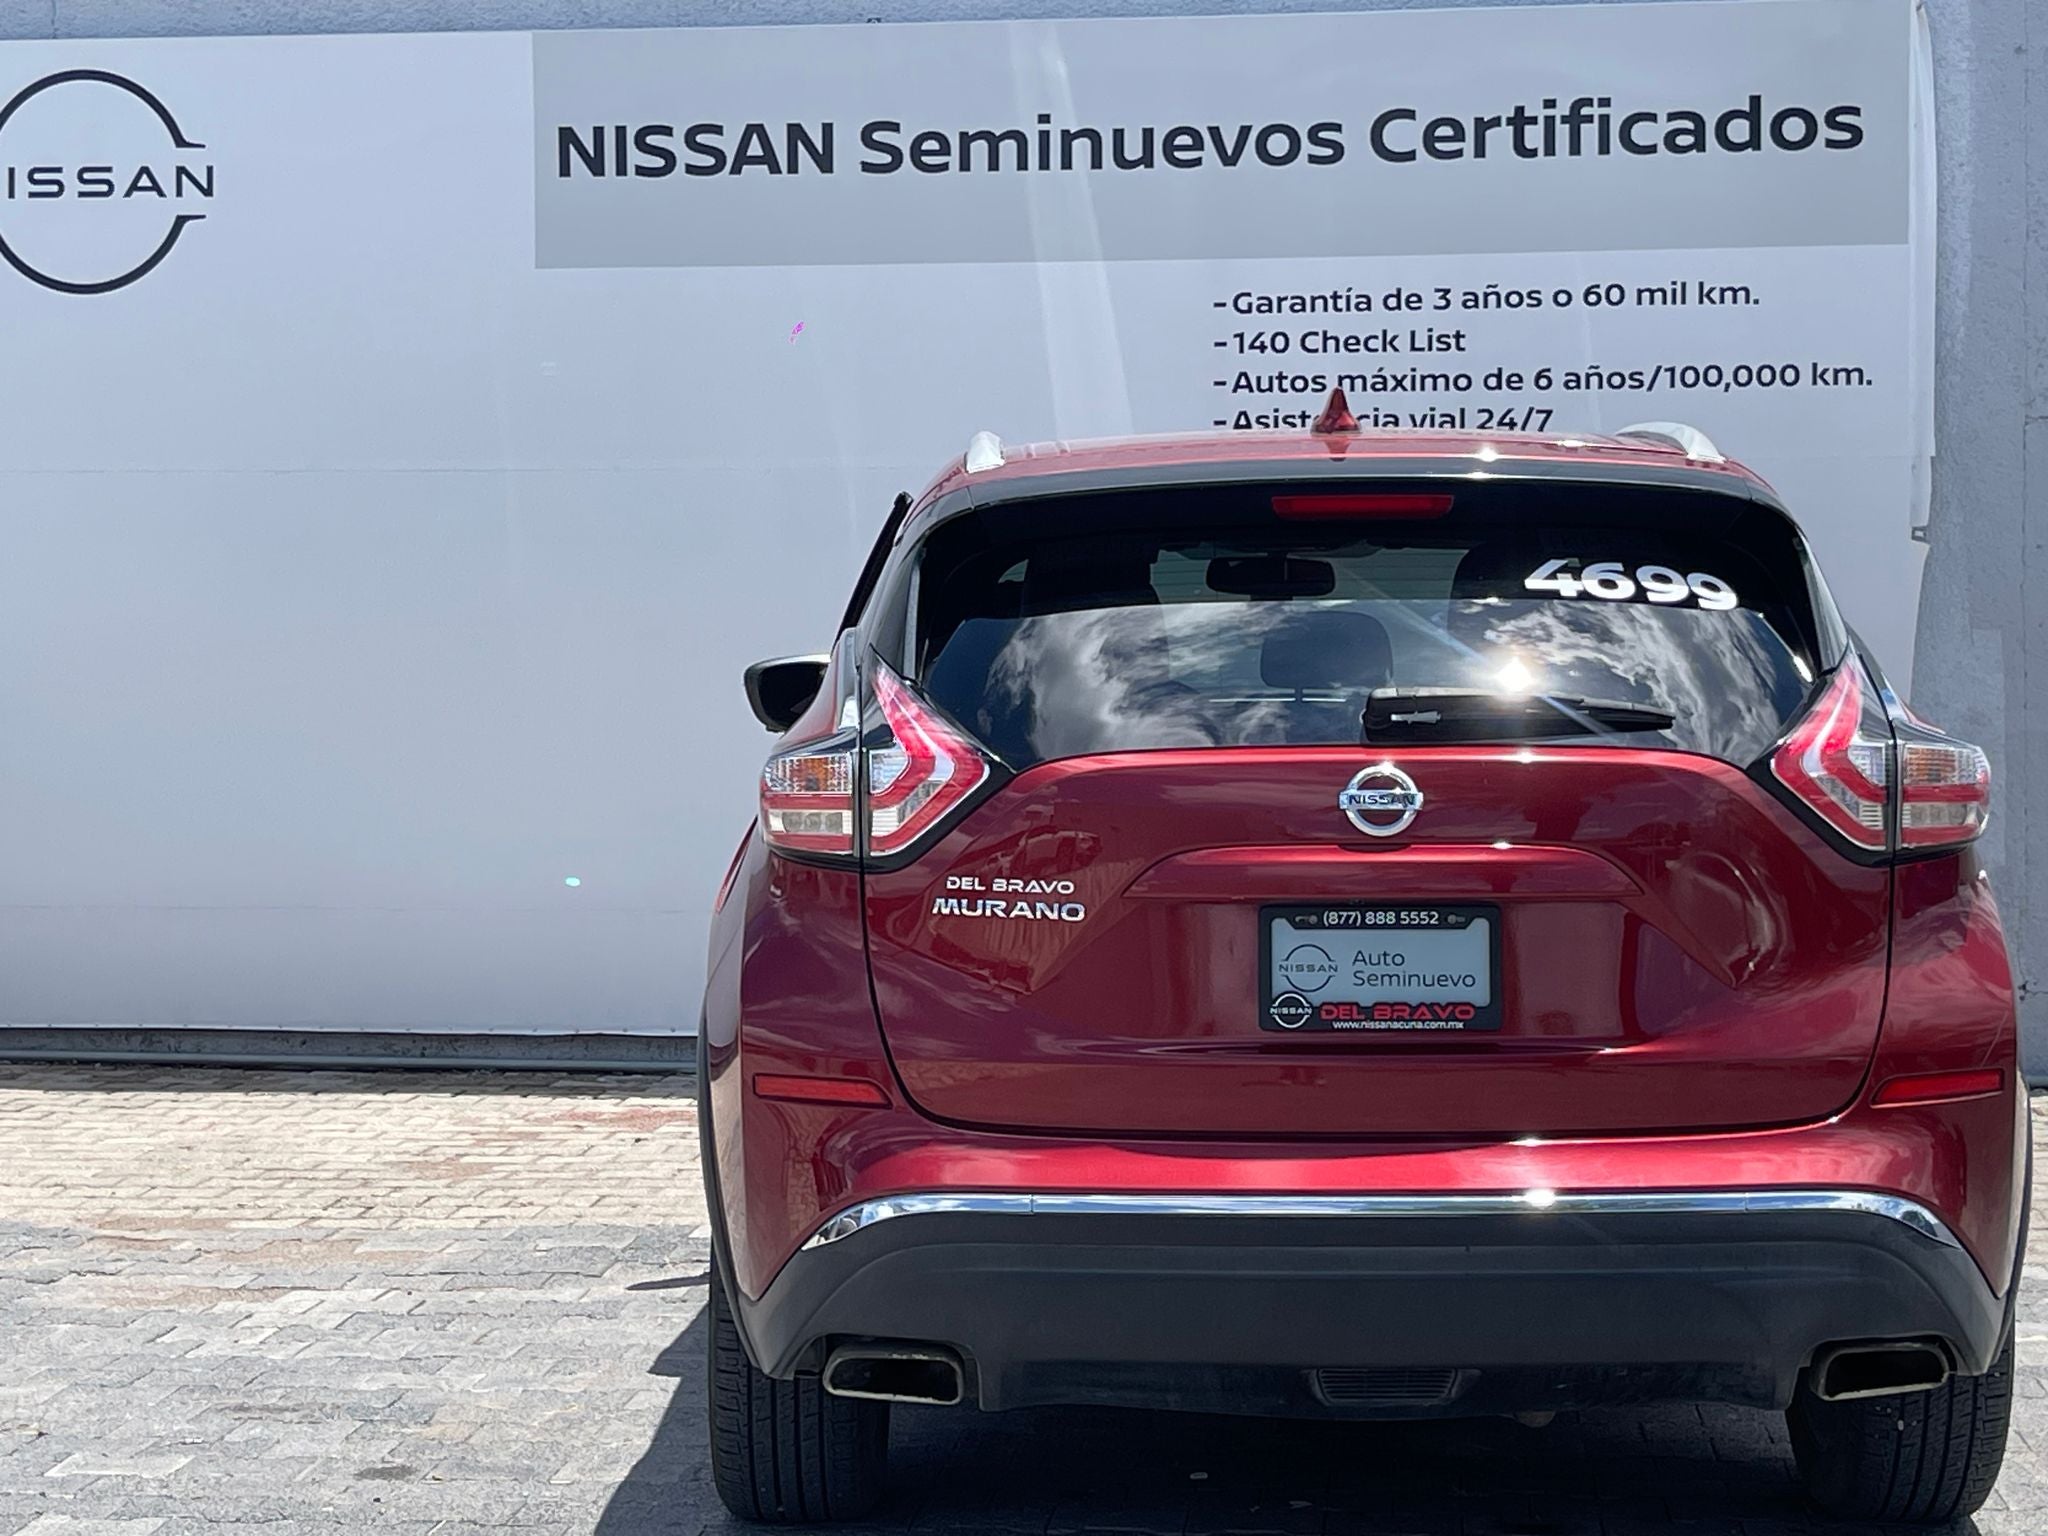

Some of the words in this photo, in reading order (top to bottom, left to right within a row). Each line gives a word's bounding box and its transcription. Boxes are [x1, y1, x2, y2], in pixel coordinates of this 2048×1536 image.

[558, 122, 834, 178] NISSAN
[859, 113, 1345, 174] Seminuevos
[1370, 94, 1864, 163] Certificados
[8, 165, 214, 198] ISSAN
[1382, 287, 1423, 312] de
[1433, 287, 1452, 311] 3
[1461, 283, 1543, 310] años
[1552, 289, 1573, 308] o
[1583, 283, 1626, 307] 60
[1636, 280, 1687, 306] mil
[1698, 281, 1760, 305] km.
[1300, 328, 1400, 354] Check
[1409, 327, 1466, 352] List
[1336, 366, 1473, 393] máximo
[1483, 366, 1524, 391] de
[1533, 367, 1553, 391] 6
[1562, 363, 1801, 393] años/100,000
[1811, 362, 1873, 386] km.
[1408, 406, 1466, 430] vial
[1476, 406, 1554, 433] 24/7
[1524, 558, 1739, 611] 4699
[1348, 793, 1416, 807] NISSAN
[946, 876, 986, 891] DEL
[992, 878, 1075, 895] BRAVO
[932, 897, 1085, 922] MURANO
[1323, 910, 1362, 927] (877)
[1365, 911, 1396, 925] 888
[1400, 910, 1440, 925] 5552
[1278, 963, 1339, 973] NISSAN
[1352, 949, 1406, 967] Auto
[1353, 970, 1476, 989] Seminuevo
[1269, 1006, 1312, 1015] NISSAN
[1320, 1005, 1365, 1020] DEL
[1373, 1005, 1475, 1020] BRAVO
